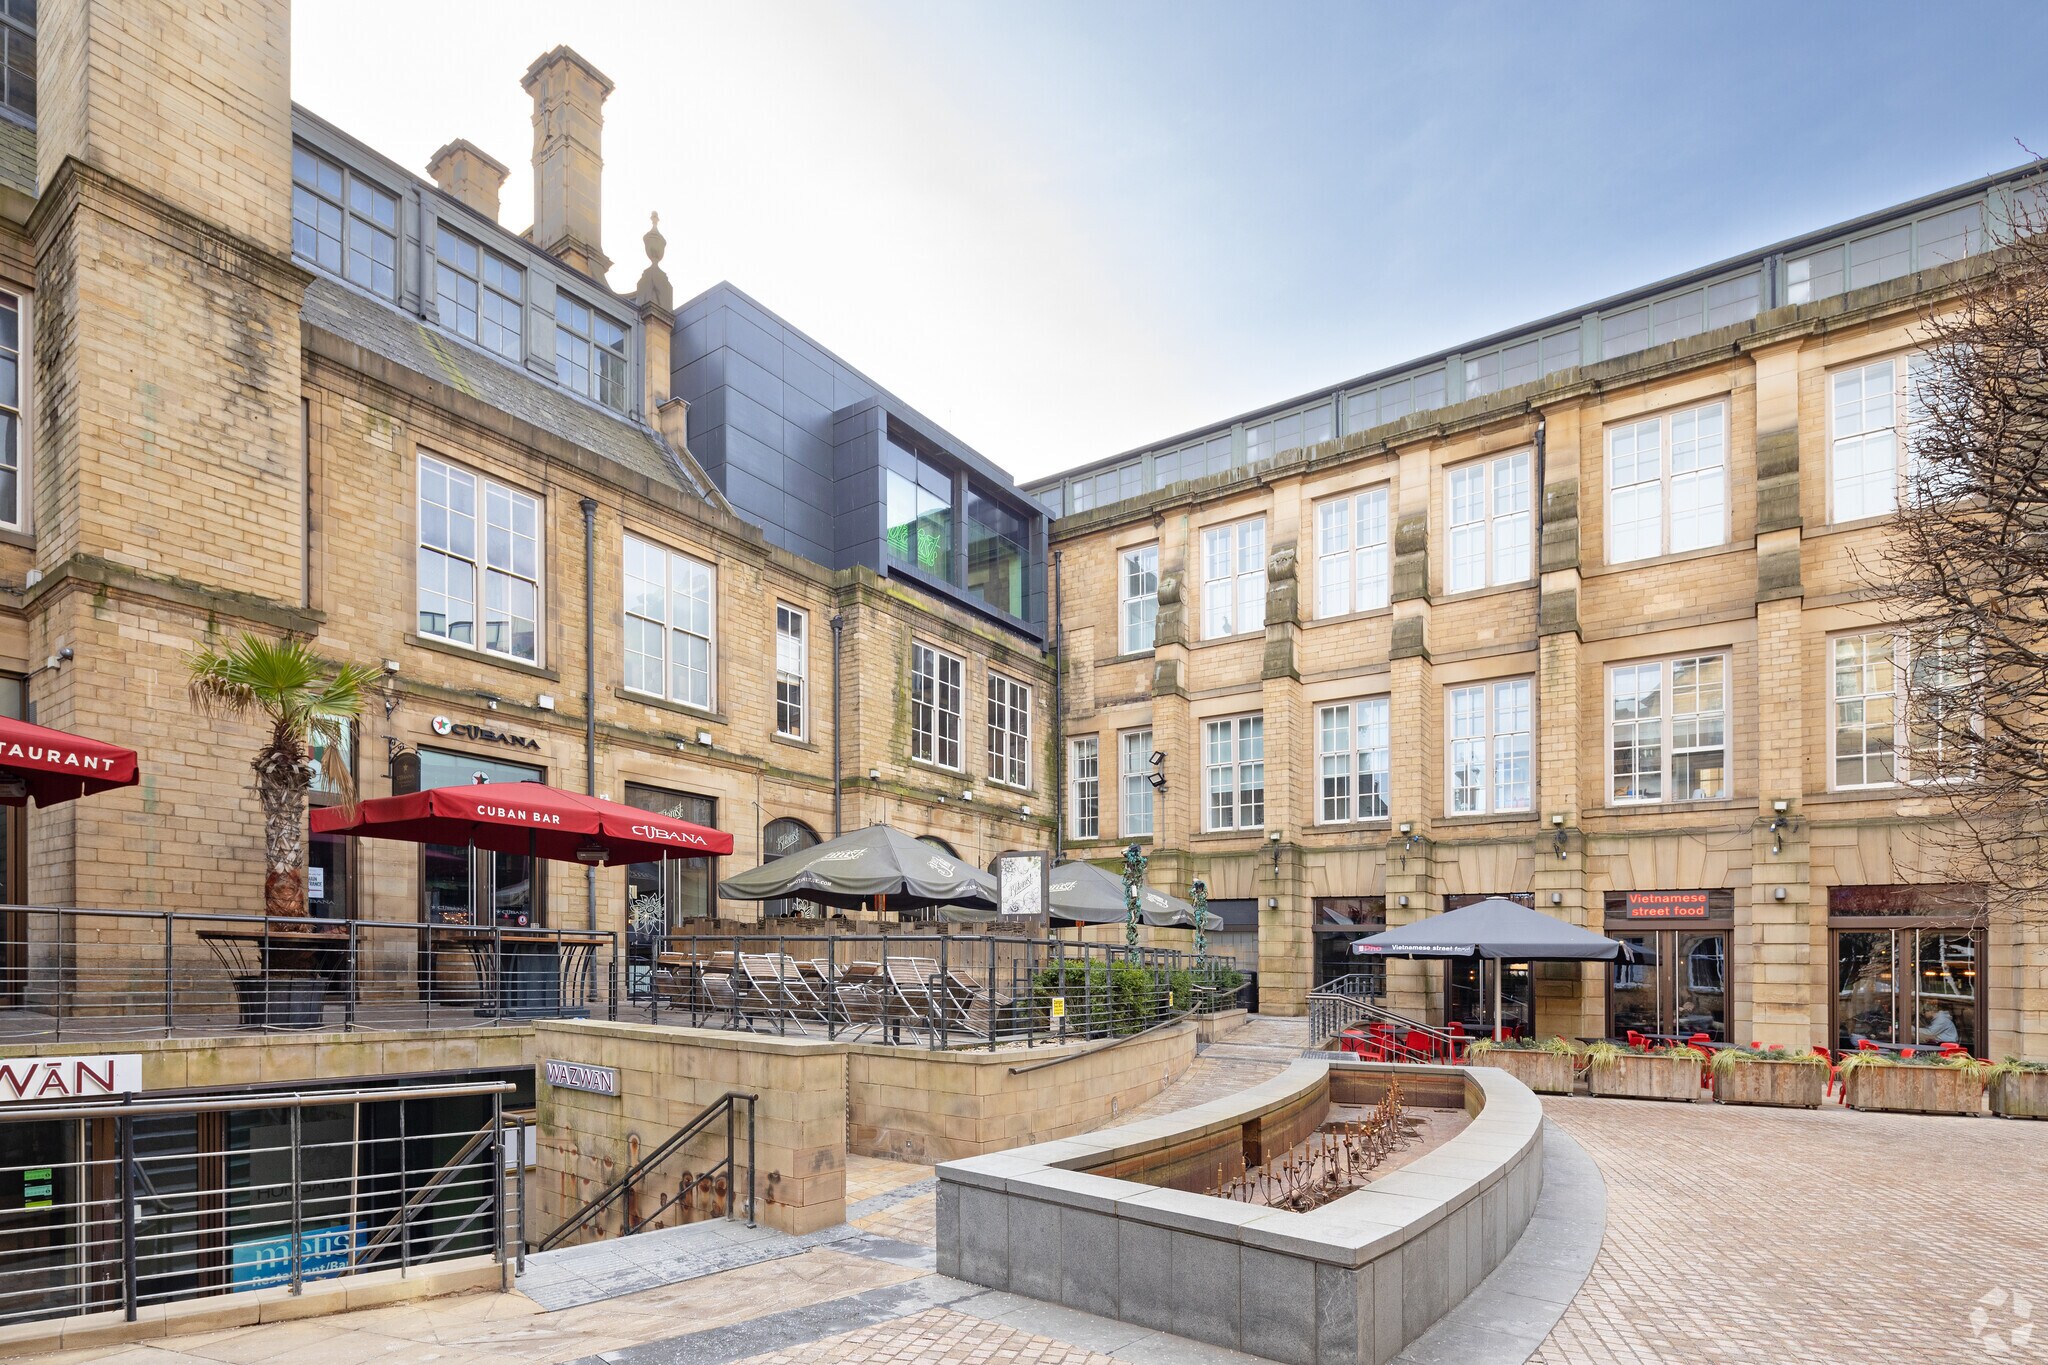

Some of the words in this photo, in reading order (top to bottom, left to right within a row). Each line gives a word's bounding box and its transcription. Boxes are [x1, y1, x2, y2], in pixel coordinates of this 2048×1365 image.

[451, 723, 541, 750] CUBANA
[477, 805, 527, 820] CUBAN
[533, 812, 561, 825] BAR
[631, 825, 708, 846] CUBANA
[1629, 893, 1707, 904] Vietnamese
[1631, 906, 1671, 917] street
[1674, 905, 1705, 917] food
[251, 1260, 350, 1288] Restarant/Bar
